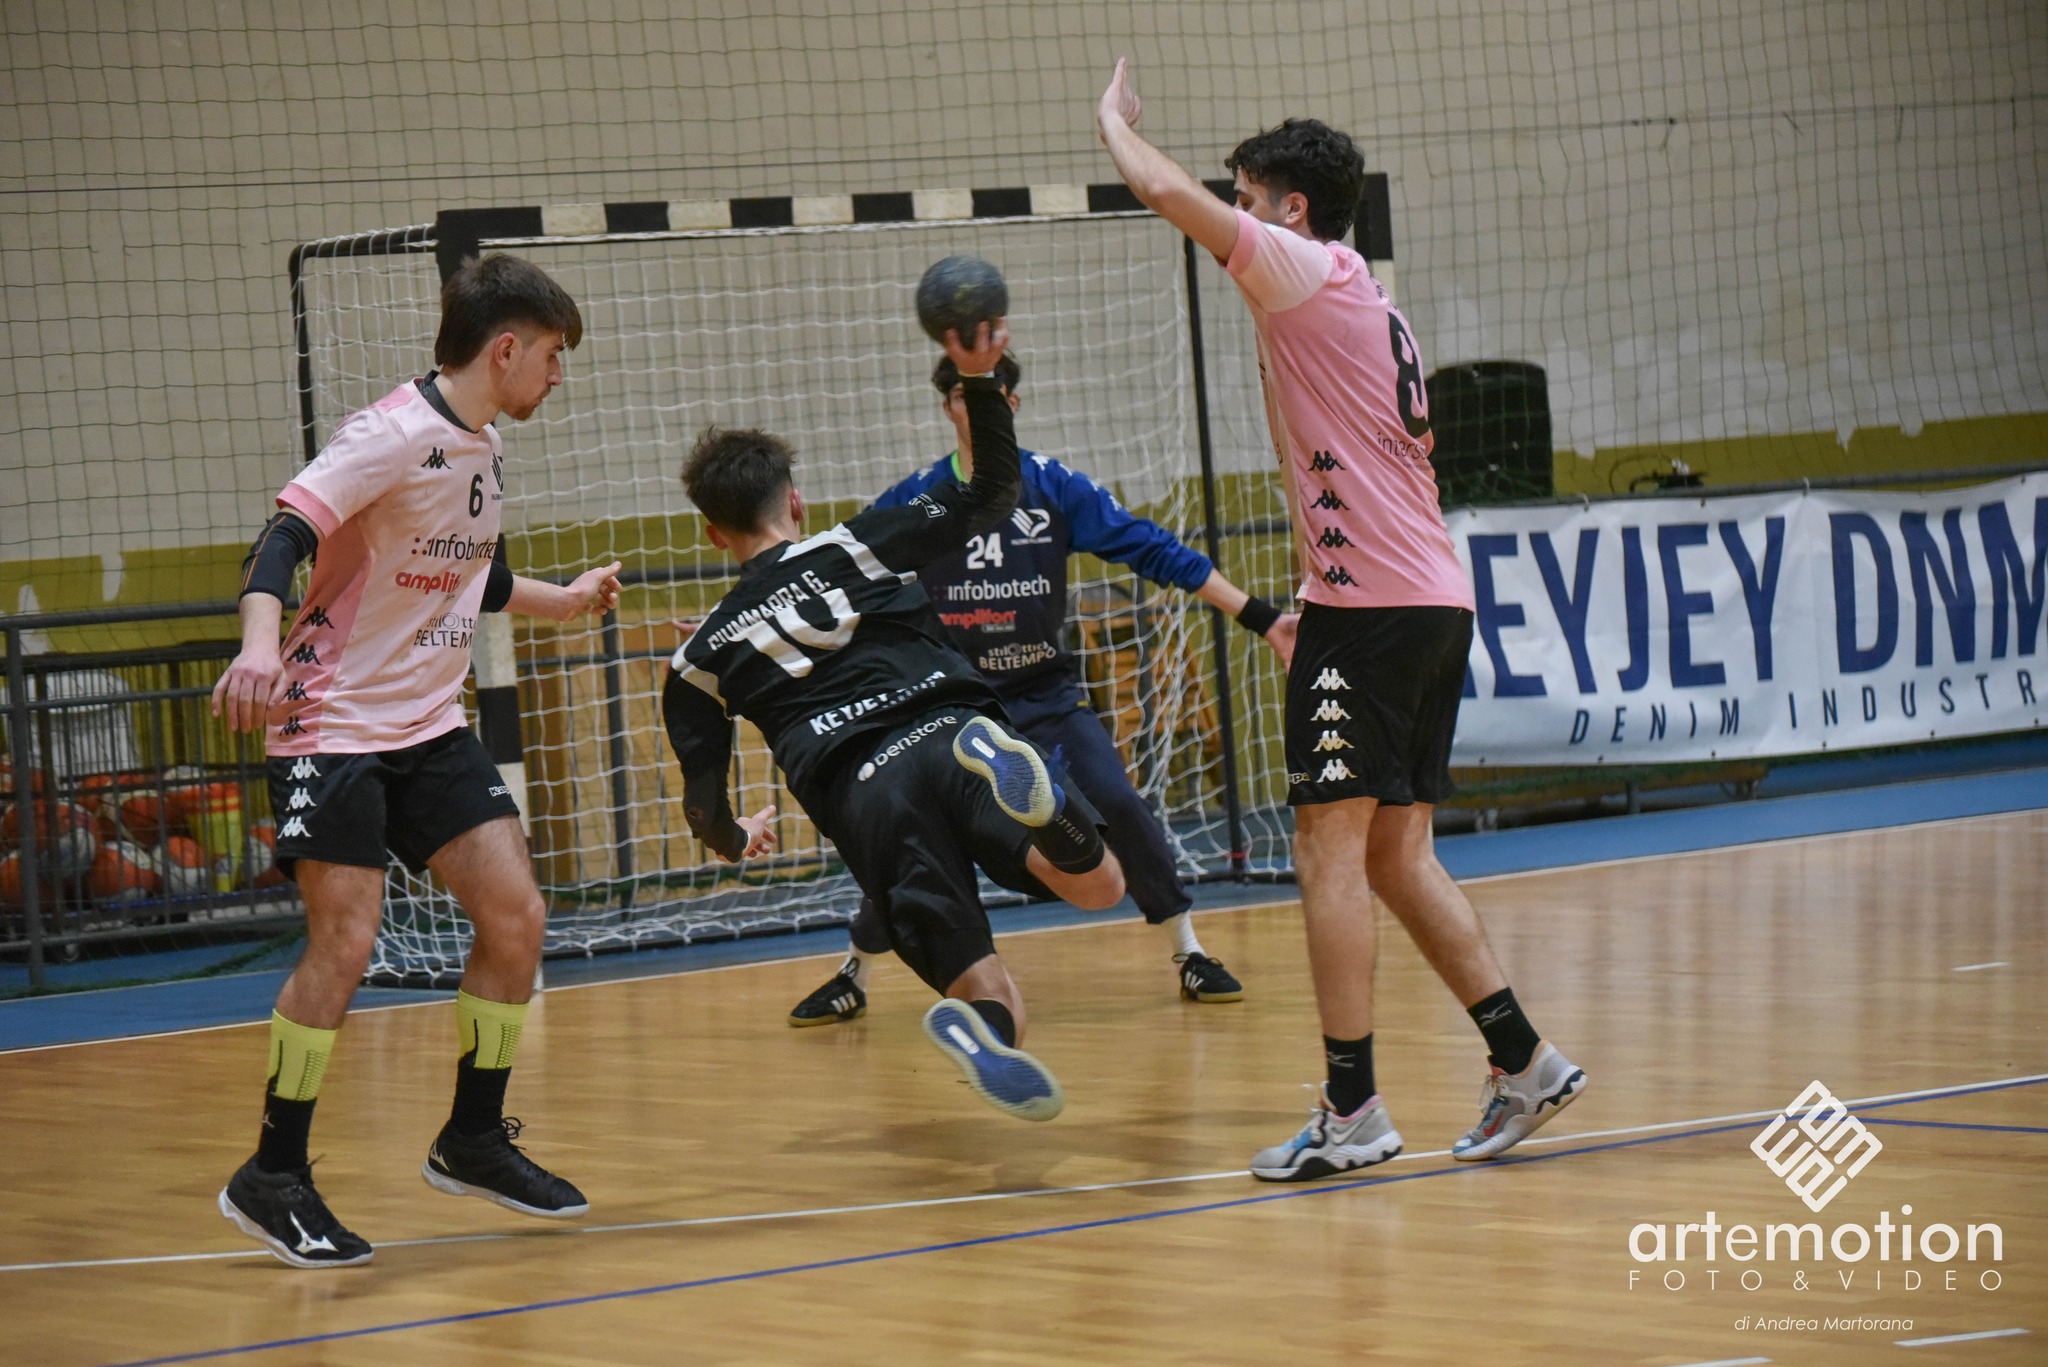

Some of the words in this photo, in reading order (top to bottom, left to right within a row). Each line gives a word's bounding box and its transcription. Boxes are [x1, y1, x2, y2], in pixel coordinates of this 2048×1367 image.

[1387, 311, 1431, 439] 8
[468, 473, 484, 518] 6
[965, 532, 1004, 570] 24
[948, 574, 1051, 601] infobiotech
[1461, 516, 1786, 698] EYJEY
[726, 587, 861, 679] 10
[978, 646, 1057, 671] BELTEMPO
[1569, 697, 1740, 746] DENIM
